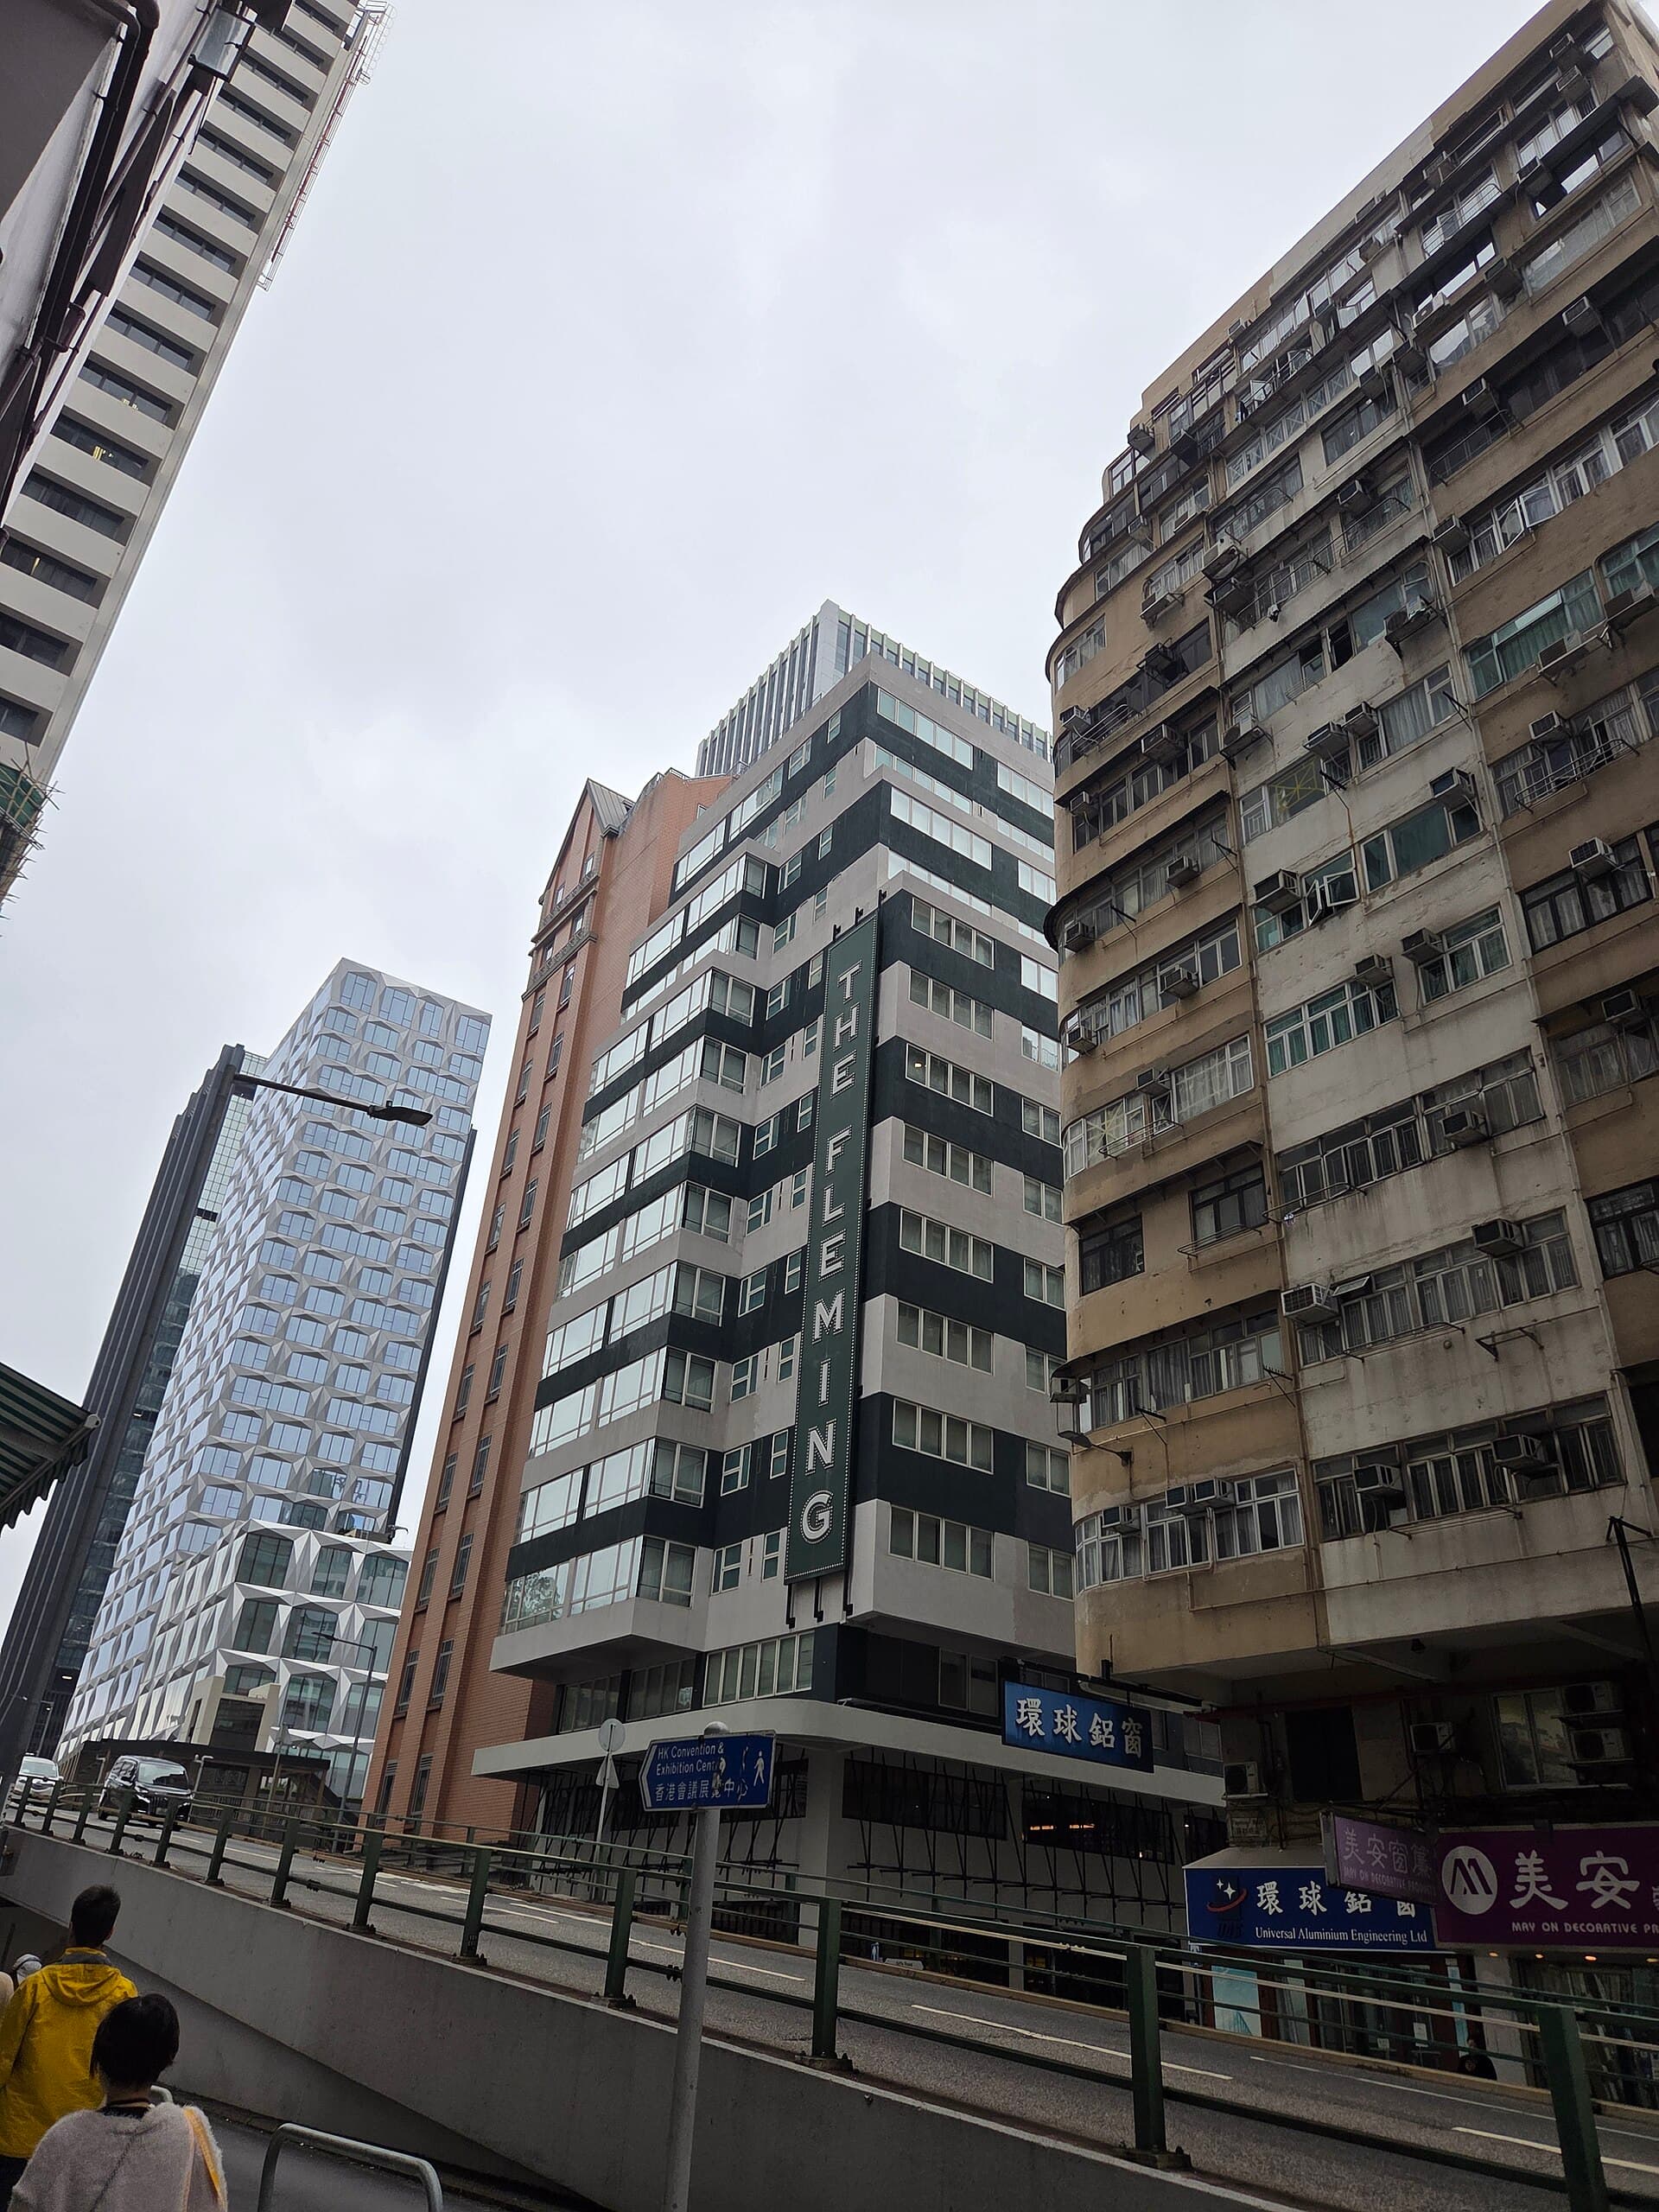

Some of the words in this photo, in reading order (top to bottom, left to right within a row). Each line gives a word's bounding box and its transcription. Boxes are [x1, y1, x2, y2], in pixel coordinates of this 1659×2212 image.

[830, 960, 862, 1099] THE
[801, 1125, 852, 1544] FLEMING
[1015, 1698, 1142, 1758] 環球鋁窗
[658, 1747, 669, 1760] HK
[671, 1744, 716, 1758] Convention
[717, 1742, 724, 1754] &
[656, 1761, 694, 1776] Exhibition
[696, 1759, 719, 1772] Cent
[1255, 1927, 1296, 1941] Universal
[1298, 1928, 1349, 1942] Aluminium
[1351, 1929, 1408, 1946] Engineering
[1410, 1929, 1428, 1943] Ltd
[1511, 1922, 1535, 1933] MAY
[1541, 1922, 1559, 1933] ON
[1564, 1922, 1638, 1934] DECORATIVE
